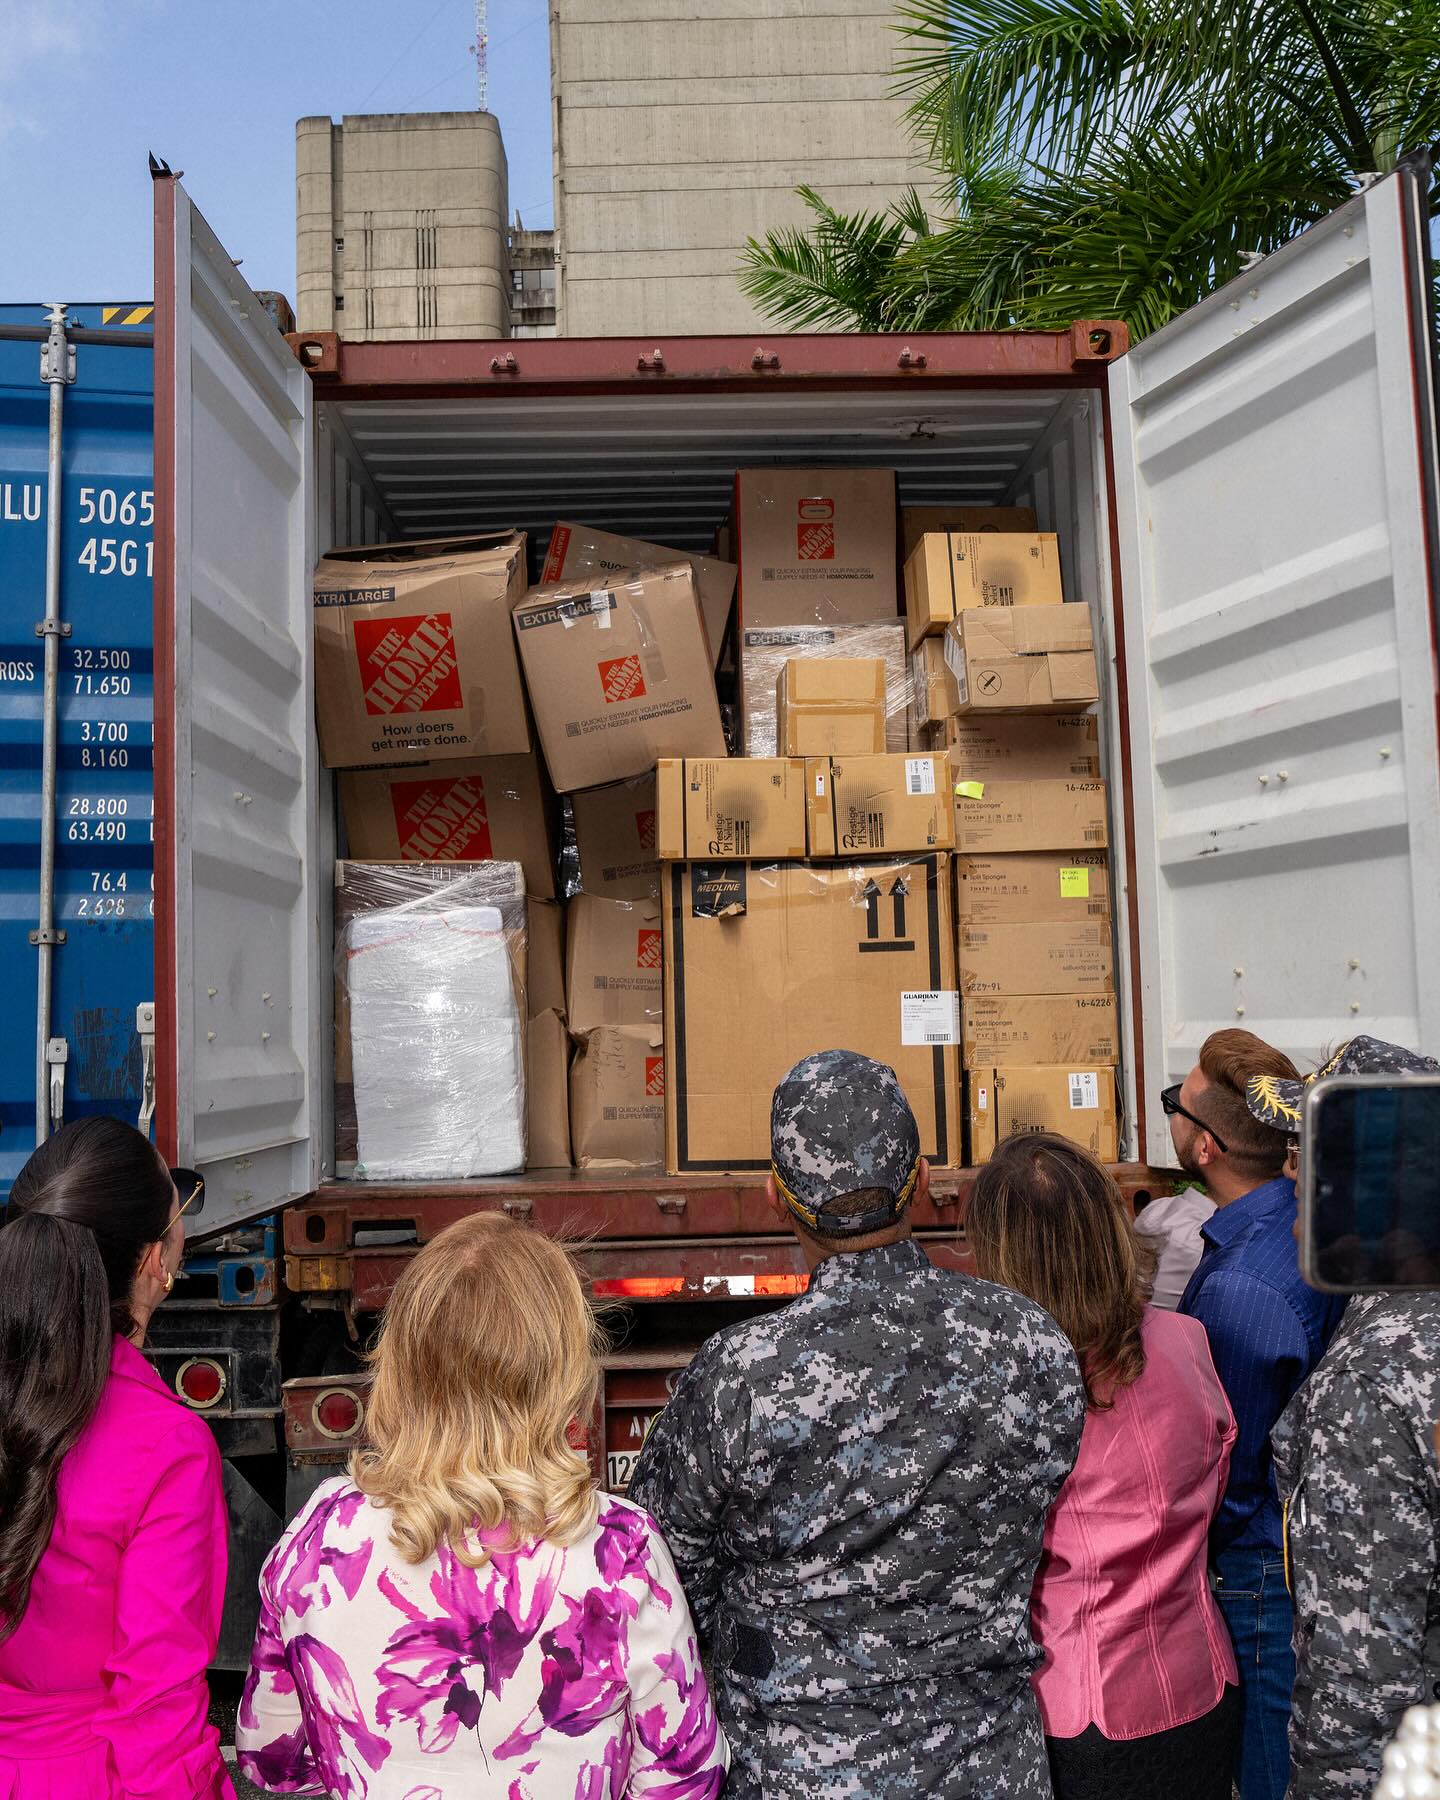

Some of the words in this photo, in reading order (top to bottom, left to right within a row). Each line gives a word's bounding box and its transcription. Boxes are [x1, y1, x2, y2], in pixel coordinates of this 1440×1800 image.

[0, 483, 41, 521] LU
[79, 488, 154, 526] 5065
[78, 538, 154, 577] 45G1
[350, 590, 390, 602] LARGE
[523, 609, 563, 627] EXTRA
[74, 649, 130, 669] 32,500
[367, 628, 406, 669] THE
[365, 614, 453, 715] HOME
[606, 663, 620, 682] THE
[74, 675, 130, 695] 71,650
[403, 650, 458, 713] DEPOT
[605, 656, 640, 702] HOME
[621, 669, 642, 699] DEPOT
[581, 716, 607, 727] QUICKLY
[609, 710, 639, 721] ESTIMATE
[640, 704, 659, 714] YOUR
[659, 698, 688, 710] PACKING
[582, 724, 607, 735] SUPPLY
[608, 719, 631, 729] NEEDS
[631, 716, 639, 724] AT
[639, 704, 693, 722] HDMOVING.COM
[81, 722, 128, 742] 3,700
[383, 724, 412, 737] How
[416, 722, 455, 735] doers
[372, 738, 396, 752] get
[397, 737, 431, 748] more
[434, 734, 472, 746] done.
[82, 748, 128, 768] 8,160
[1065, 784, 1101, 792] 16-4226
[69, 798, 128, 815] 28,800
[404, 789, 440, 824] THE
[401, 777, 484, 860] HOME
[724, 817, 733, 841] Select
[843, 806, 858, 849] Prestige
[856, 810, 867, 833] Select
[68, 822, 126, 841] 63,490
[438, 807, 488, 860] DEPOT
[708, 812, 724, 855] Prestige
[1070, 857, 1105, 865] 16-4226
[91, 872, 126, 892] 76.4
[697, 883, 741, 893] MEDLINE
[1076, 999, 1111, 1008] 16-4226
